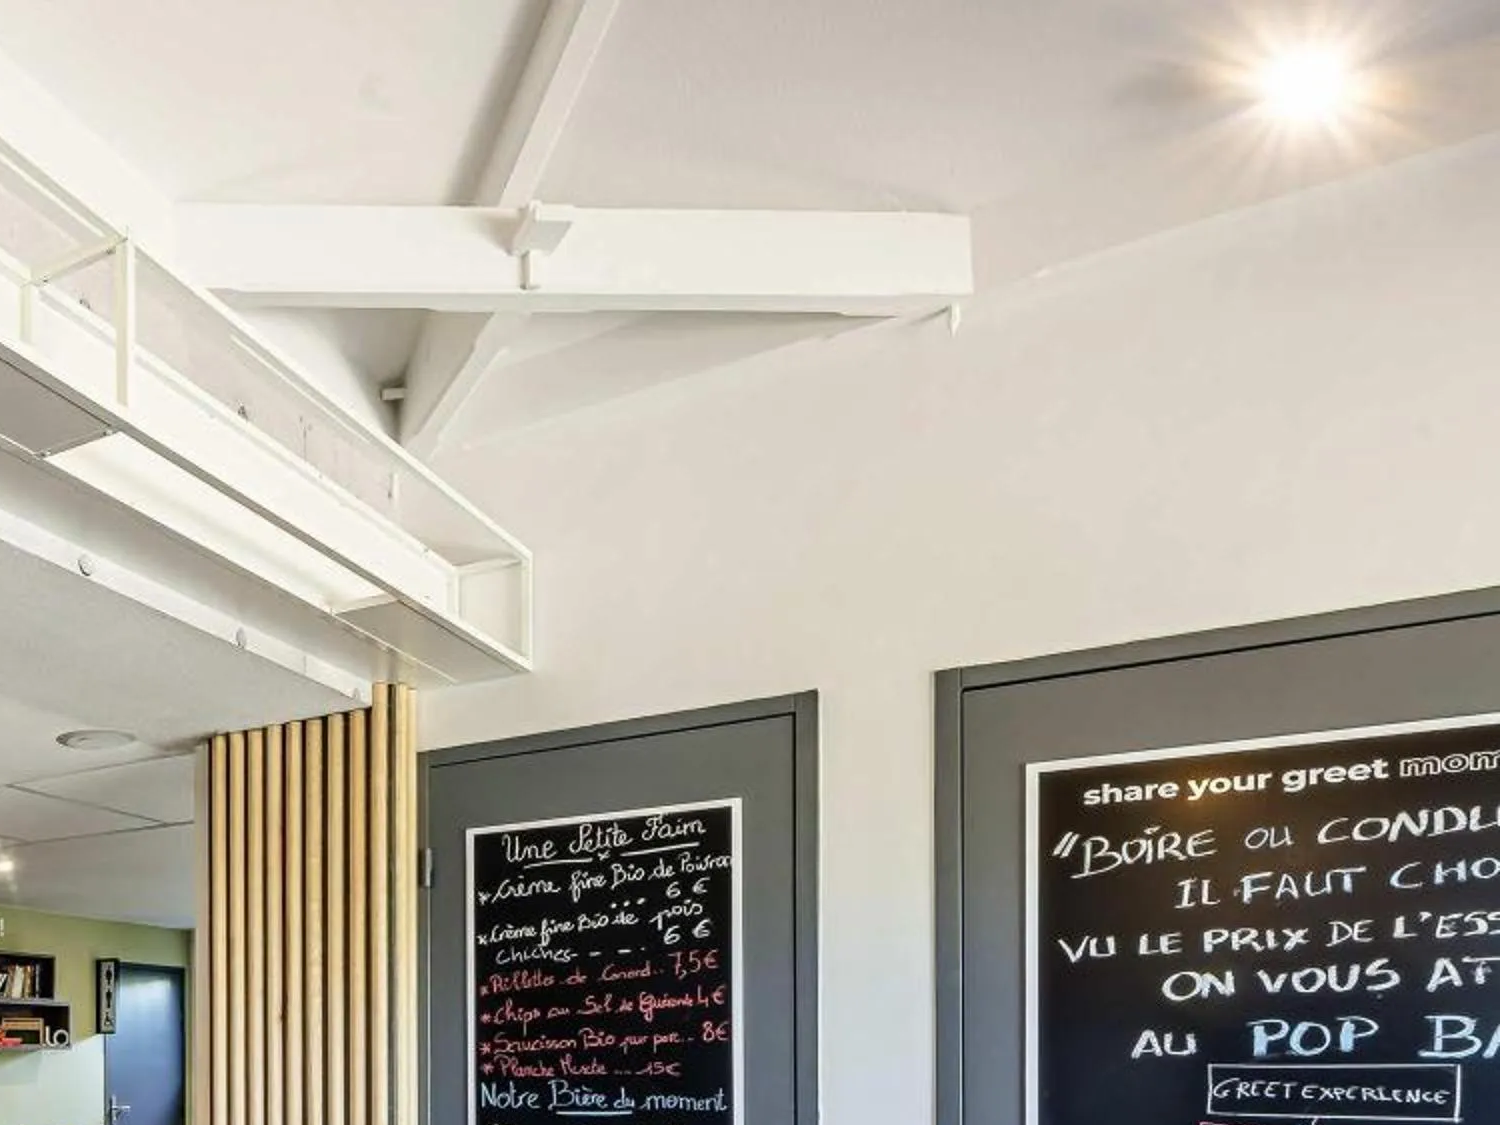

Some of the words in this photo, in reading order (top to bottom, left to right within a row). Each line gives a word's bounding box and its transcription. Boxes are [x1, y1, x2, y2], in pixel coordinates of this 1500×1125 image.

[1084, 777, 1180, 806] share
[1187, 769, 1271, 800] your
[1281, 758, 1388, 792] greet
[501, 833, 558, 863] Une
[641, 813, 707, 842] Faim
[1244, 826, 1295, 850] OU
[611, 862, 646, 889] Bio
[647, 857, 676, 880] de
[1174, 877, 1221, 909] IL
[1237, 866, 1366, 905] FAUT
[1058, 935, 1117, 963] VU
[1137, 931, 1183, 956] LE
[1202, 926, 1311, 953] PRIX
[1325, 919, 1375, 949] DE
[1162, 970, 1236, 1001] ON
[1256, 957, 1401, 994] VOUS
[1130, 1028, 1197, 1059] AU
[1246, 1015, 1380, 1057] POP
[480, 1081, 541, 1109] Notre
[547, 1078, 607, 1111] Bière
[613, 1087, 636, 1109] du
[640, 1087, 729, 1112] moment
[1213, 1077, 1298, 1100] GREET
